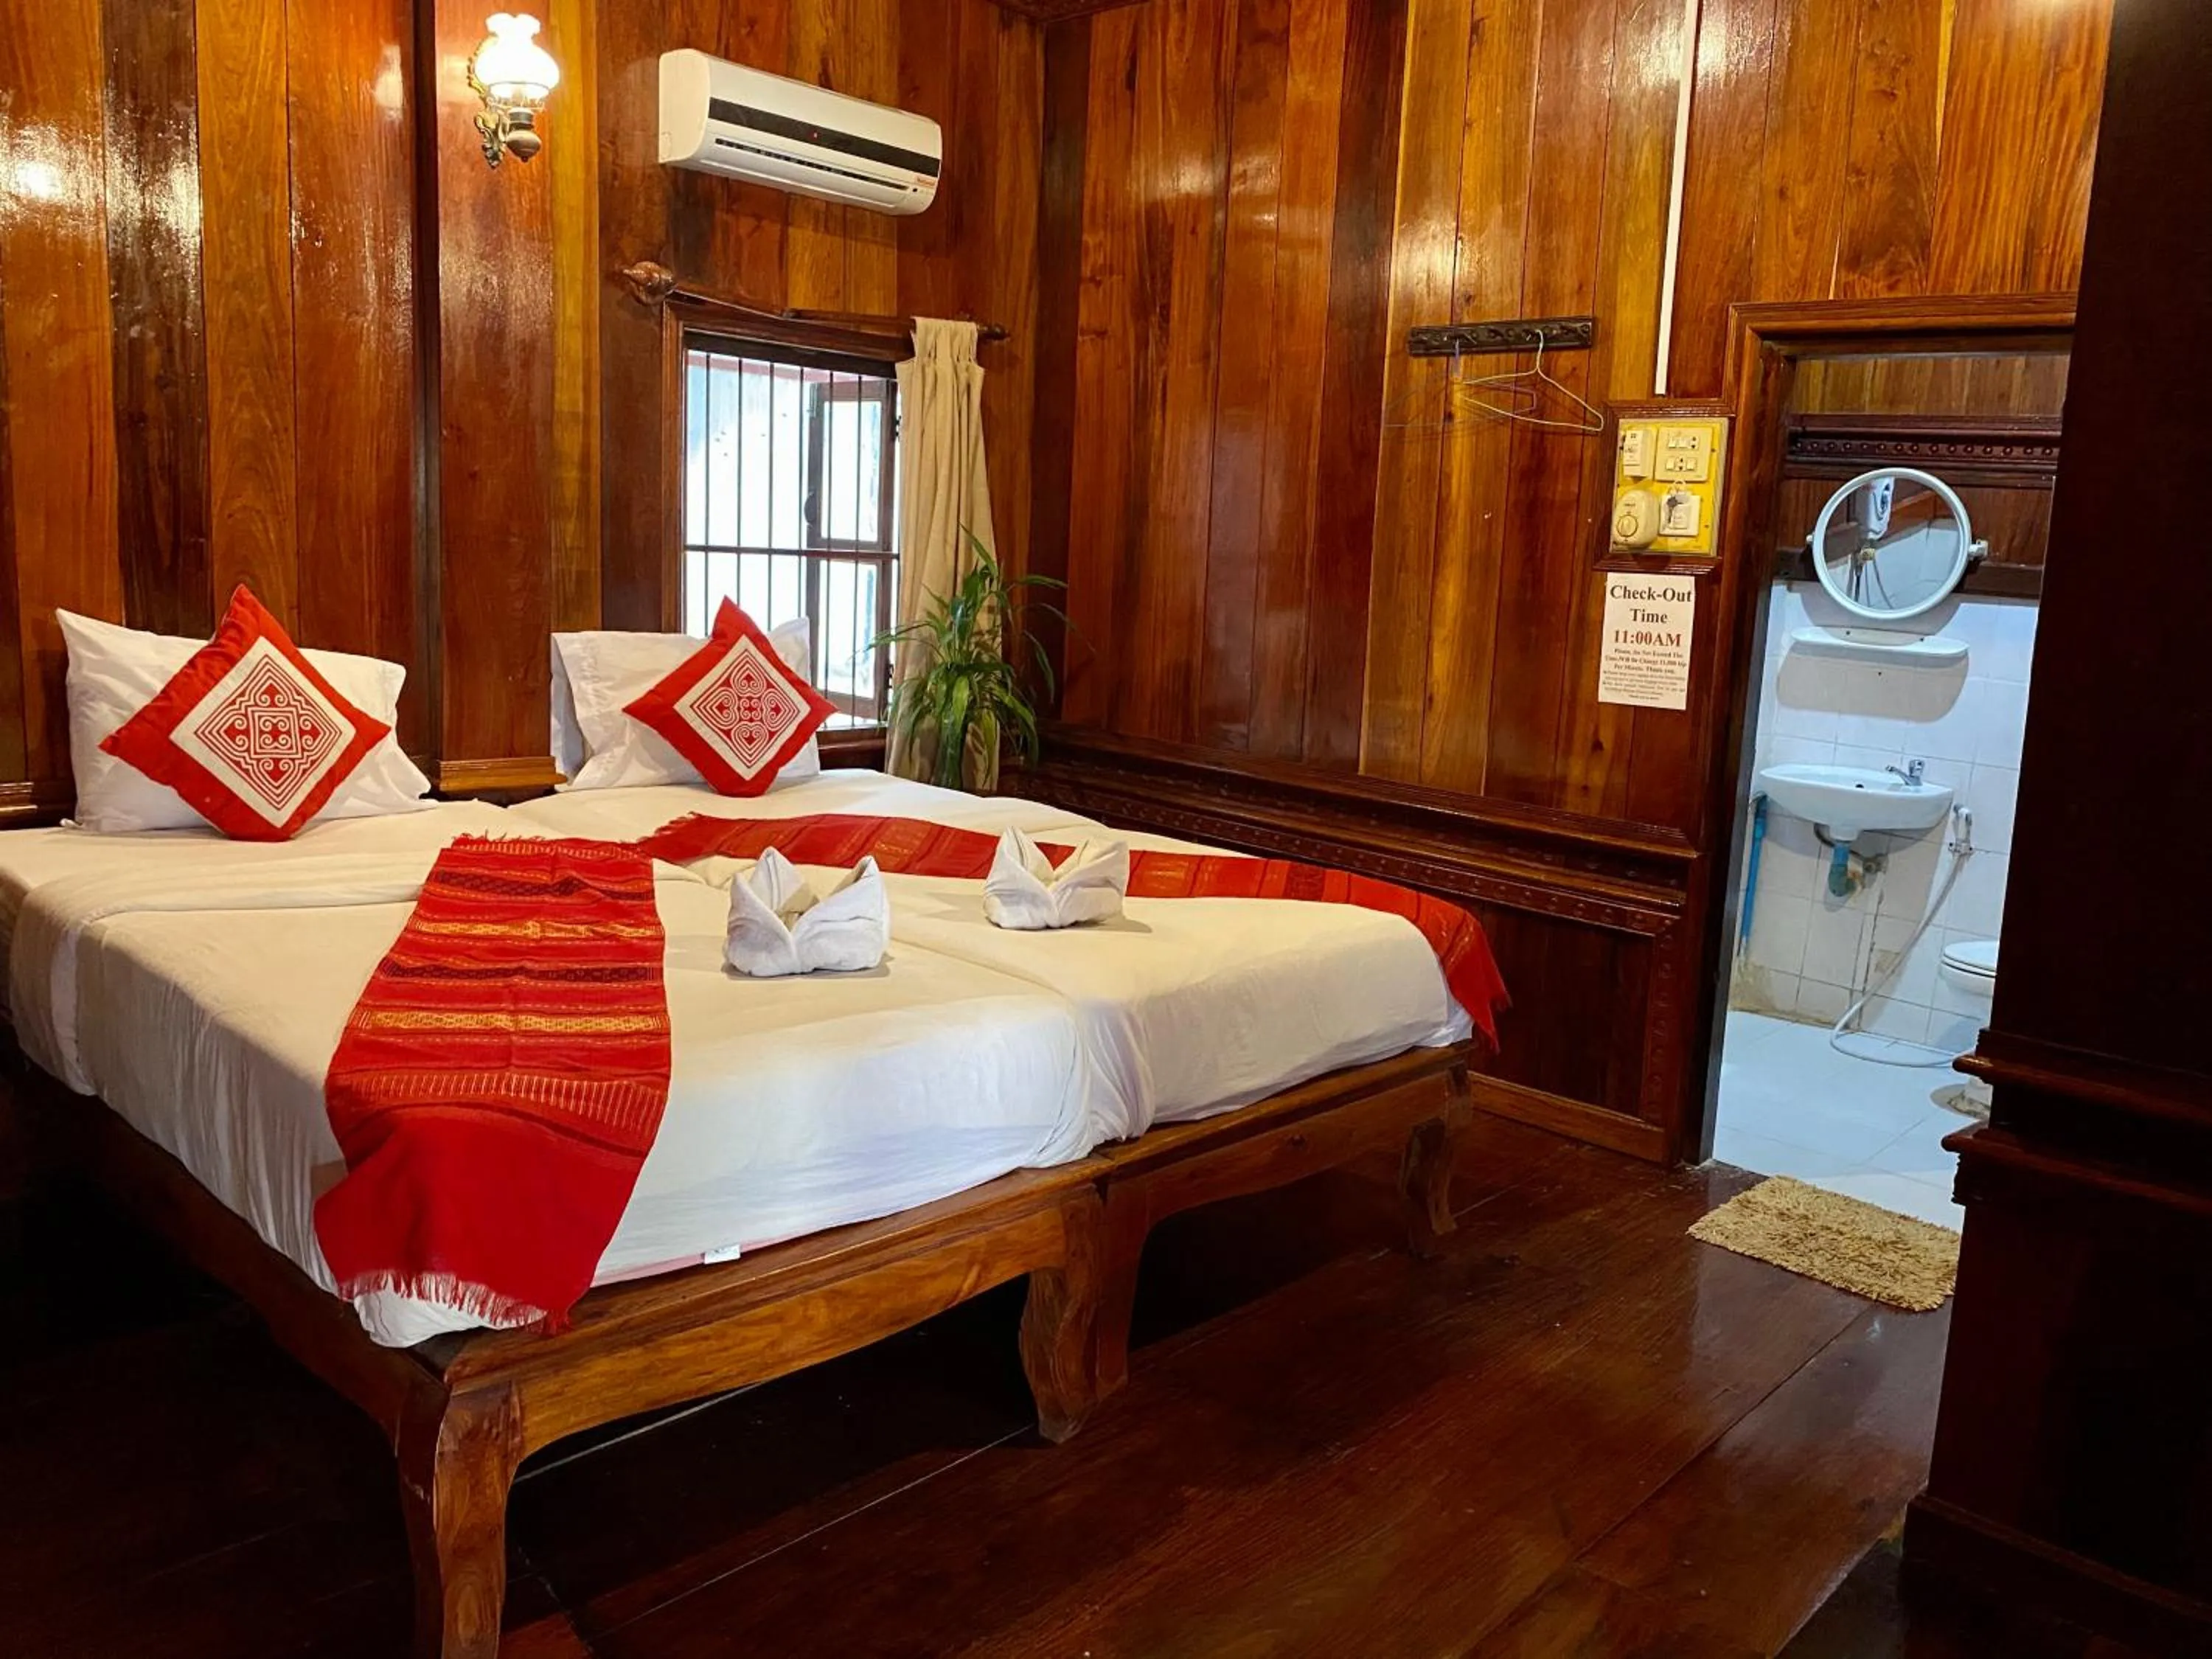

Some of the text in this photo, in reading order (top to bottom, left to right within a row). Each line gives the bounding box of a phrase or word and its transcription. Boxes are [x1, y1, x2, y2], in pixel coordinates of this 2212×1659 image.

[1610, 585, 1692, 602] Check-Out
[1630, 608, 1668, 623] Time
[1615, 630, 1681, 647] 11:00AM
